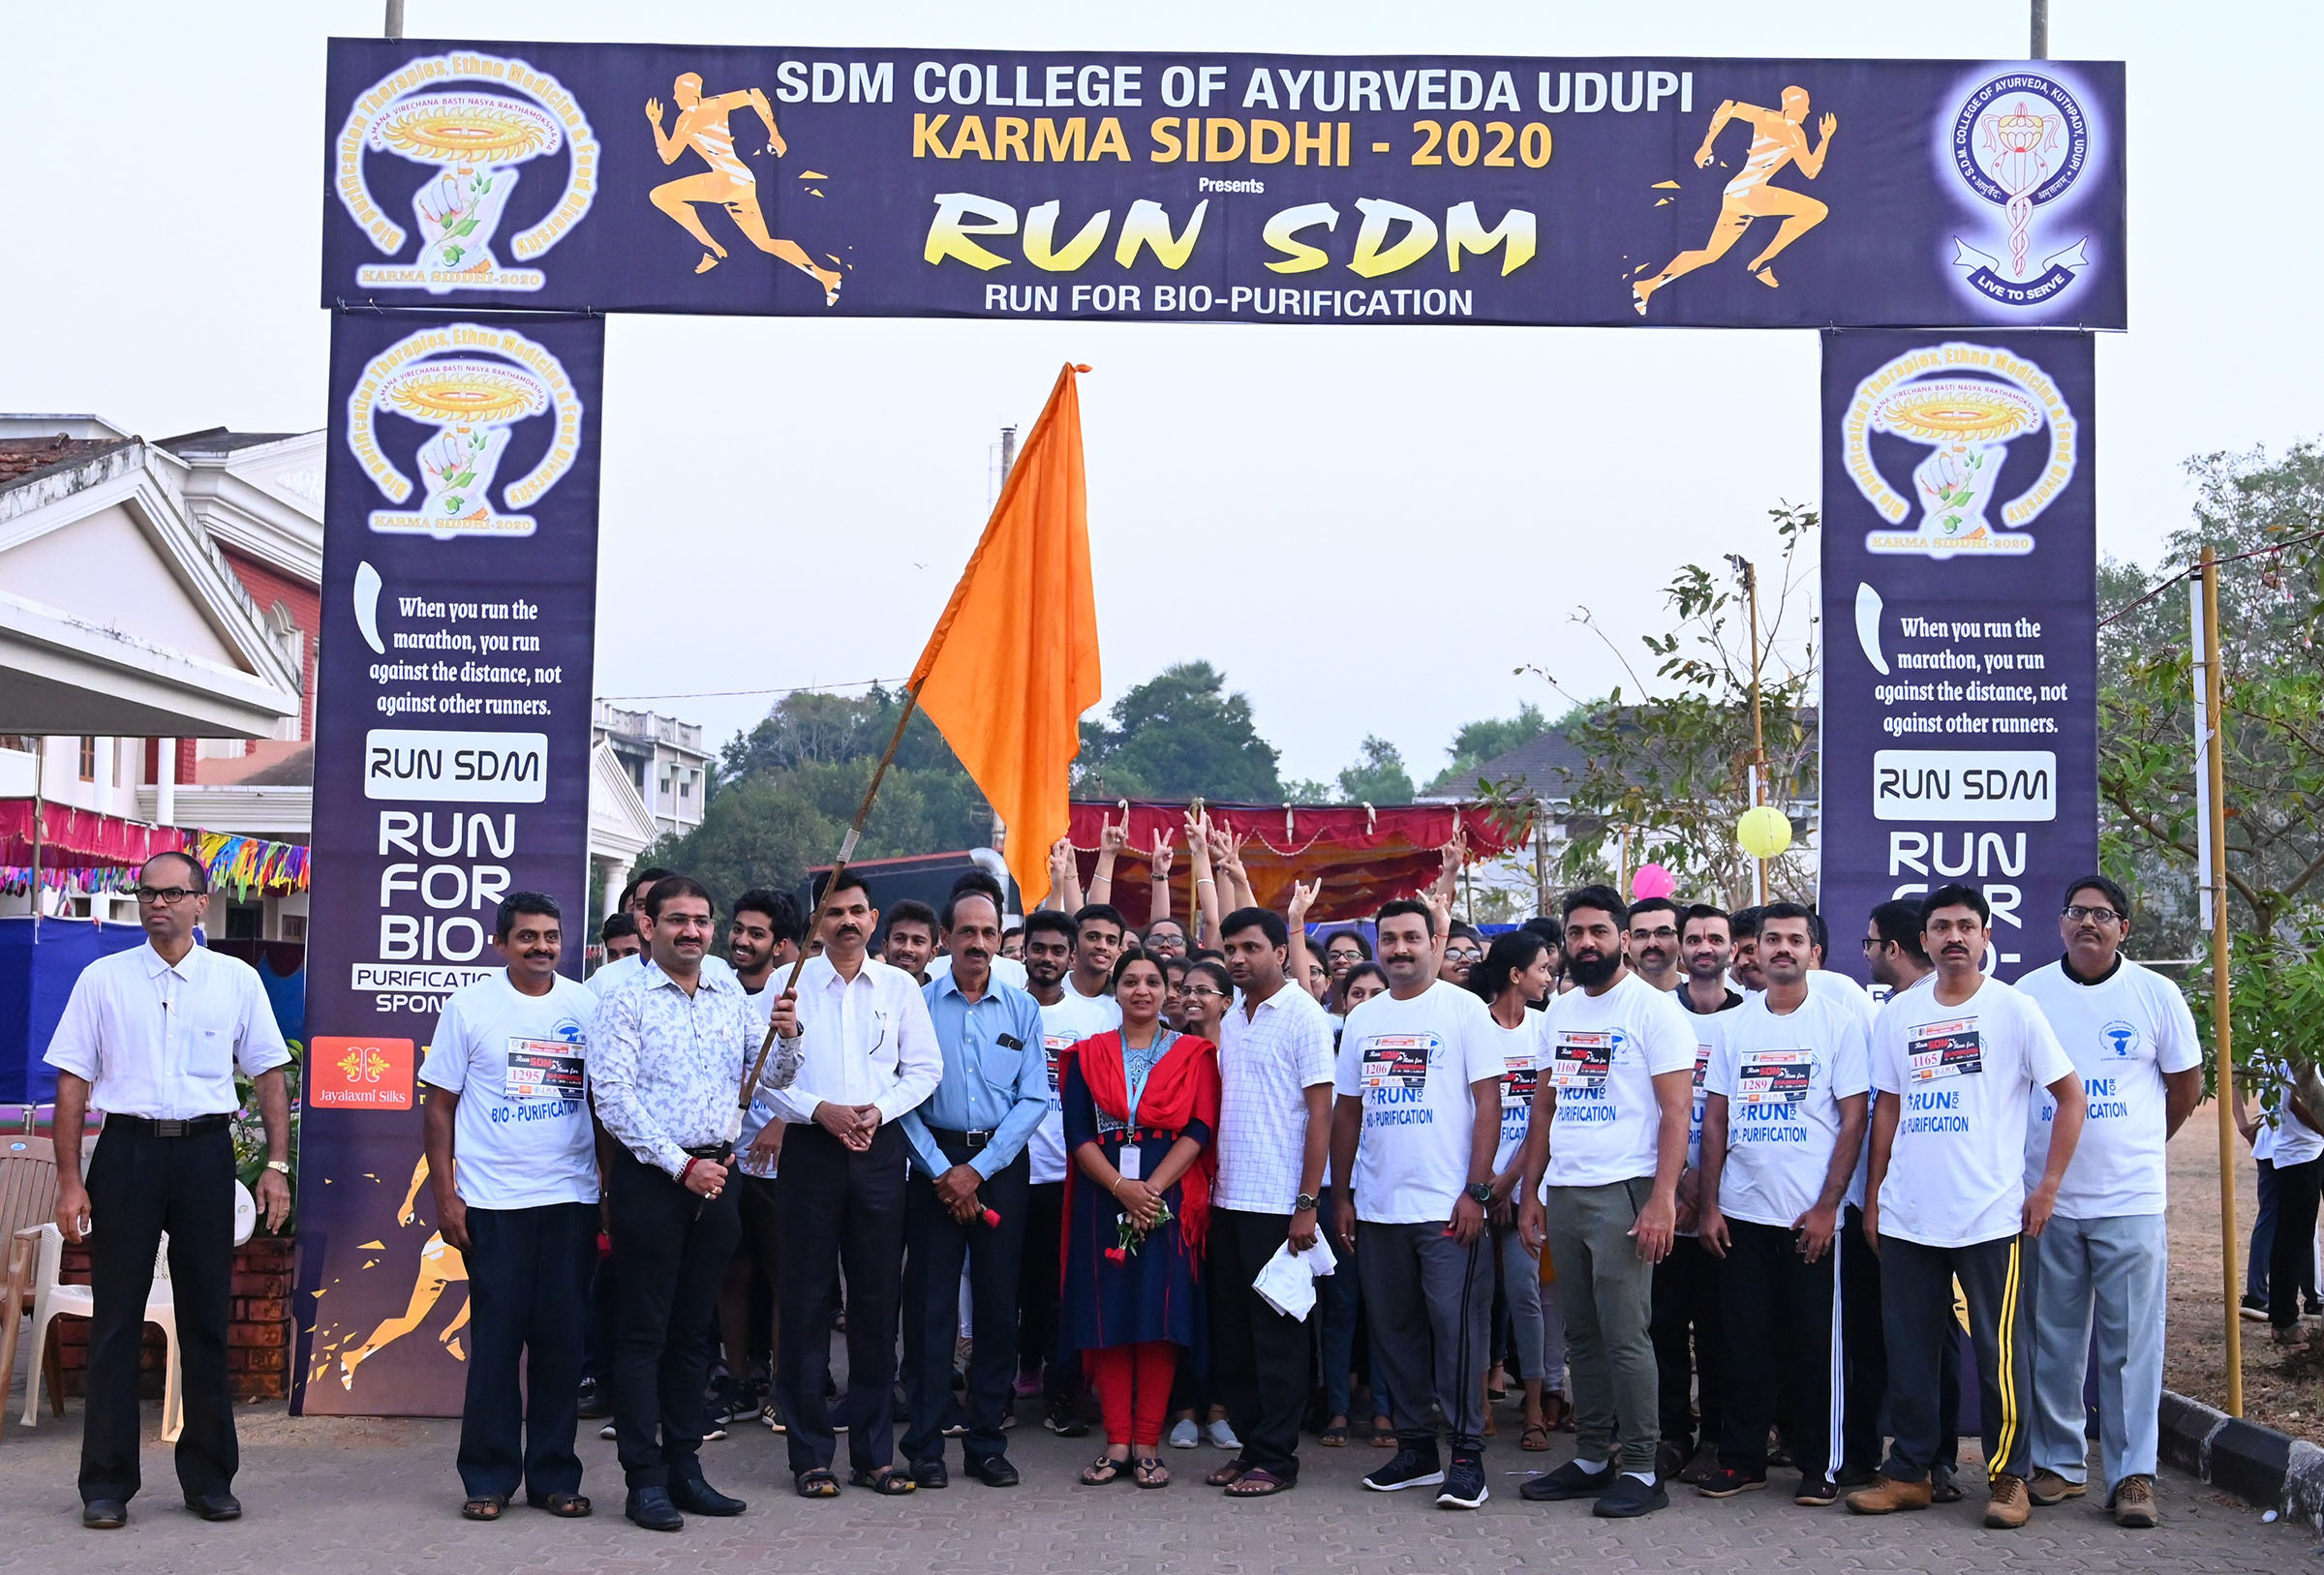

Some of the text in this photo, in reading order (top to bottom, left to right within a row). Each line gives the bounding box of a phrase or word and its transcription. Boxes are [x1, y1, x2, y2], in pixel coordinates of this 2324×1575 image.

[452, 57, 504, 78] Ethno
[507, 63, 581, 127] Medicine
[776, 60, 1693, 113] SDM COLLEGE OF AYURVEDA UDUPI
[370, 112, 391, 147] VAMANA
[393, 99, 440, 118] VIRECHANA
[468, 98, 495, 107] NASYA
[498, 101, 558, 150] RAKTHAMOKSHANA
[573, 127, 587, 142] &
[1956, 77, 2085, 178] S.D.M. COLLEGE OF AYURVEDA, KUTHPADY, UDUPI
[912, 112, 1553, 168] KARMA SIDDHI - 2020
[573, 143, 595, 191] Food
[1199, 177, 1265, 195] Presents
[372, 220, 402, 251] Bio
[924, 192, 1537, 279] RUN SDM
[361, 269, 540, 286] KARMA SIDDHI-2020
[1977, 273, 2065, 300] LIVE TO SERVE
[985, 285, 1473, 316] RUN FOR BIO-PURIFICATION
[501, 335, 566, 390] Medicine
[381, 377, 398, 408] VAMANA
[399, 365, 441, 381] VIRECHANA
[466, 365, 490, 374] NASYA
[492, 367, 545, 411] RAKTHAMOKSHANA
[558, 391, 571, 404] &
[1874, 397, 1891, 427] VAMANA
[1892, 385, 1933, 400] VIRECHANA
[1958, 384, 1982, 393] NASYA
[560, 405, 577, 447] Food
[375, 516, 430, 528] KARMA
[1872, 537, 1928, 548] KARMA
[398, 596, 538, 623] When you run the
[393, 629, 540, 655] marathon, you run
[1901, 617, 2041, 643] When you run the
[369, 659, 563, 686] against the distance, not
[1897, 649, 2045, 675] marathon, you run
[377, 691, 552, 716] against other runners.
[1875, 680, 2068, 705] against the distance, not
[1882, 712, 2059, 737] against other runners.
[371, 747, 539, 782] RUN SDM
[1880, 769, 2048, 801] RUN SDM
[379, 810, 516, 859] RUN
[1889, 832, 2027, 877] RUN
[381, 863, 511, 910] FOR
[380, 915, 494, 962] BIO
[376, 994, 446, 1014] SPON
[1366, 1064, 1387, 1075] 1206
[1557, 1061, 1576, 1073] 1168
[1913, 1053, 1938, 1068] 1165
[512, 1069, 539, 1082] 1295
[1743, 1079, 1767, 1090] 1289
[320, 1089, 376, 1104] Jayalaxmi
[379, 1090, 406, 1103] Silks
[1378, 1088, 1416, 1105] RUN
[1912, 1092, 1951, 1110] RUN
[518, 1100, 579, 1122] PURIFICATION
[1376, 1108, 1433, 1127] PURIFICATION
[1747, 1104, 1789, 1121] RUN
[2086, 1102, 2127, 1119] ICATION
[1742, 1127, 1807, 1142] PURIFICATION
[1908, 1116, 1969, 1133] PURIFICATION
